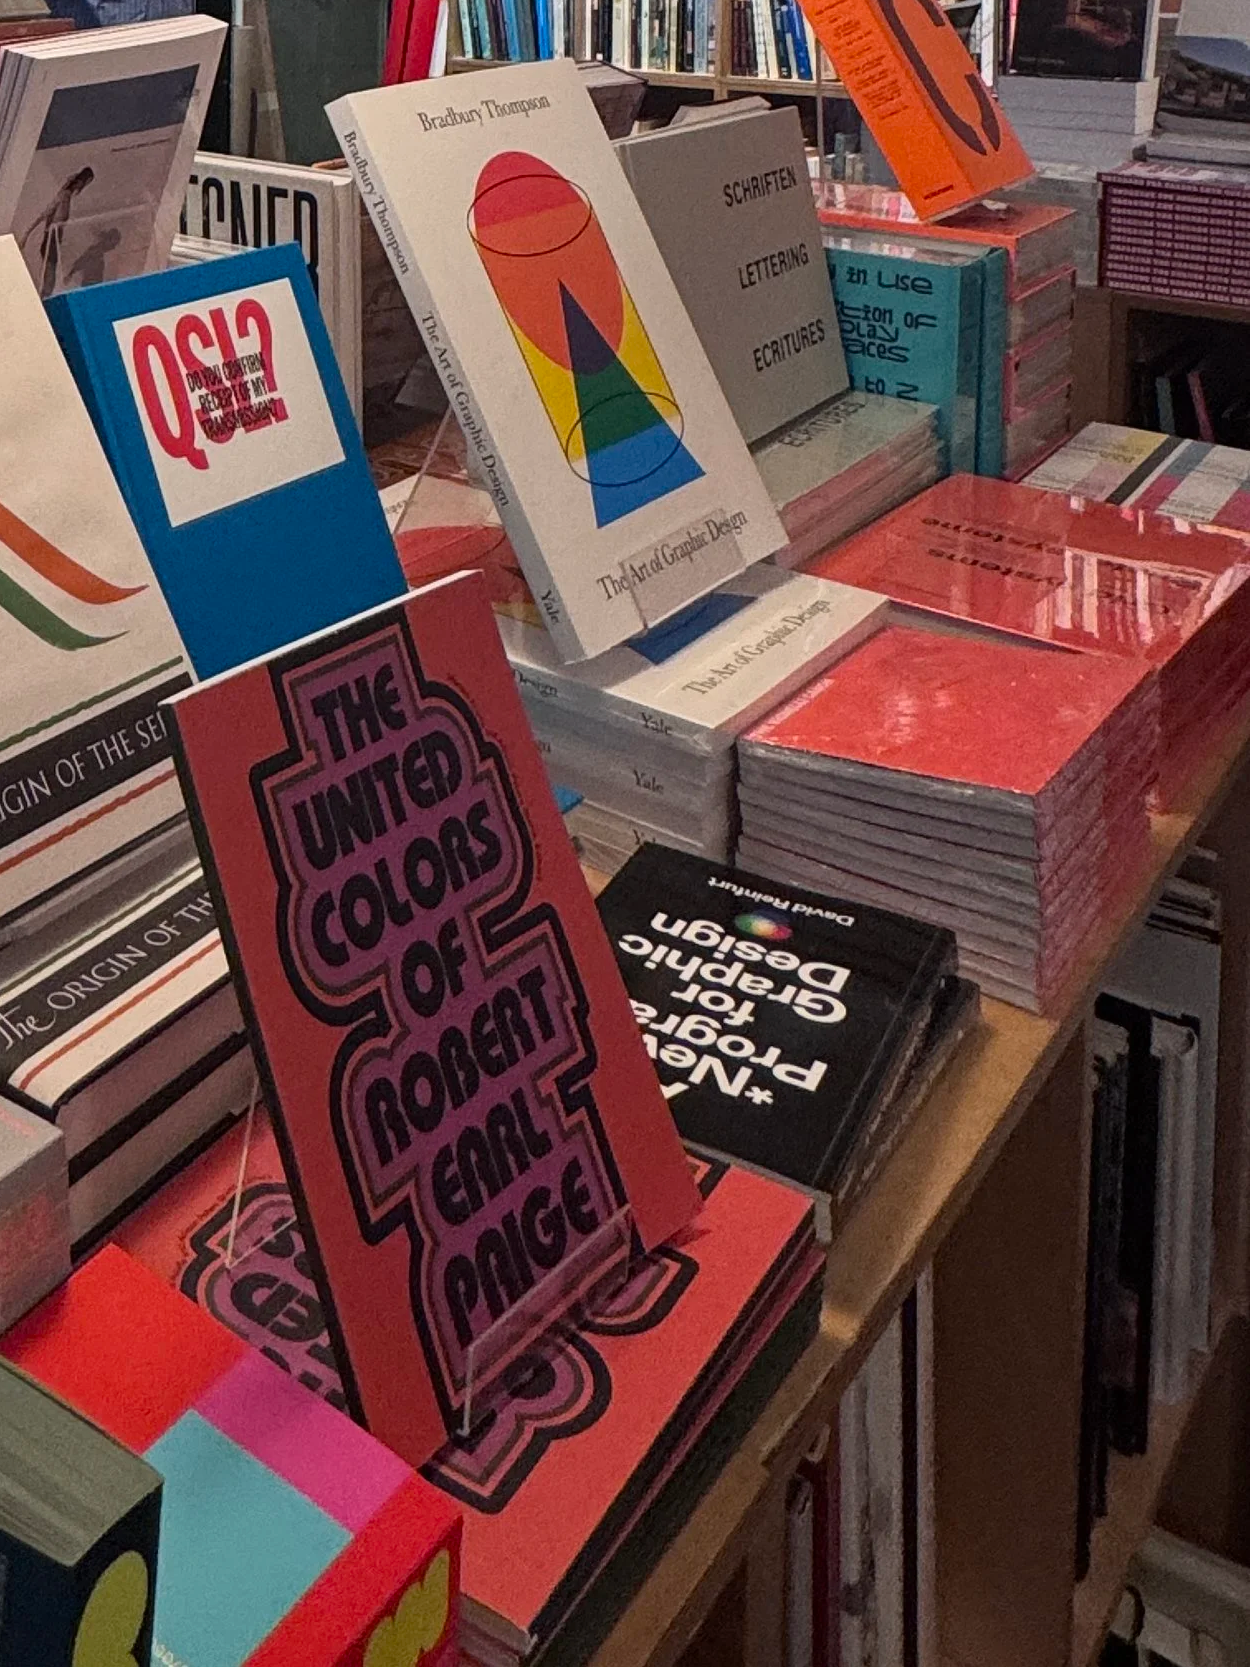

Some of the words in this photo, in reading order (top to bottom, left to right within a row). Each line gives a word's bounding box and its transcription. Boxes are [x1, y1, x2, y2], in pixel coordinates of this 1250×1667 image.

[418, 103, 483, 133] Bradbury
[481, 92, 551, 128] Thompson
[343, 130, 375, 194] Bradbury
[371, 193, 410, 275] Thompson
[722, 165, 797, 208] SCHRIFTEN
[737, 243, 810, 290] LETTERING
[846, 265, 868, 287] in
[876, 269, 934, 296] Use
[420, 311, 438, 343] The
[753, 318, 826, 373] ECRITURES
[844, 337, 910, 364] aces
[433, 342, 452, 370] Art
[448, 370, 461, 390] of
[132, 298, 290, 471] QSL?
[864, 376, 886, 396] to
[454, 390, 488, 454] Graphic
[480, 452, 510, 507] Design
[596, 572, 630, 602] The
[627, 561, 653, 587] Art
[649, 555, 663, 582] of
[659, 530, 709, 572] Graphic
[704, 509, 748, 542] Design
[538, 587, 562, 626] Yale
[681, 673, 714, 695] The
[711, 658, 738, 681] Art
[734, 644, 752, 667] of
[746, 618, 793, 662] Graphic
[784, 598, 831, 630] Design
[309, 659, 410, 747] THE
[641, 712, 673, 735] Yale
[53, 757, 90, 794] OF
[88, 731, 136, 783] THE
[632, 769, 664, 794] Yale
[292, 730, 467, 871] UNITED
[310, 800, 504, 967] COLORS
[707, 876, 791, 912] Reinfurt
[791, 898, 855, 927] David
[46, 944, 148, 1011] ORIGIN
[144, 920, 182, 947] OF
[401, 918, 472, 1018] OF
[618, 934, 847, 1024] Graphic
[650, 911, 851, 994] Design
[671, 983, 756, 1026] for
[362, 963, 563, 1165] ROBERT
[430, 1081, 555, 1230] EARL
[440, 1155, 603, 1348] PAIGE
